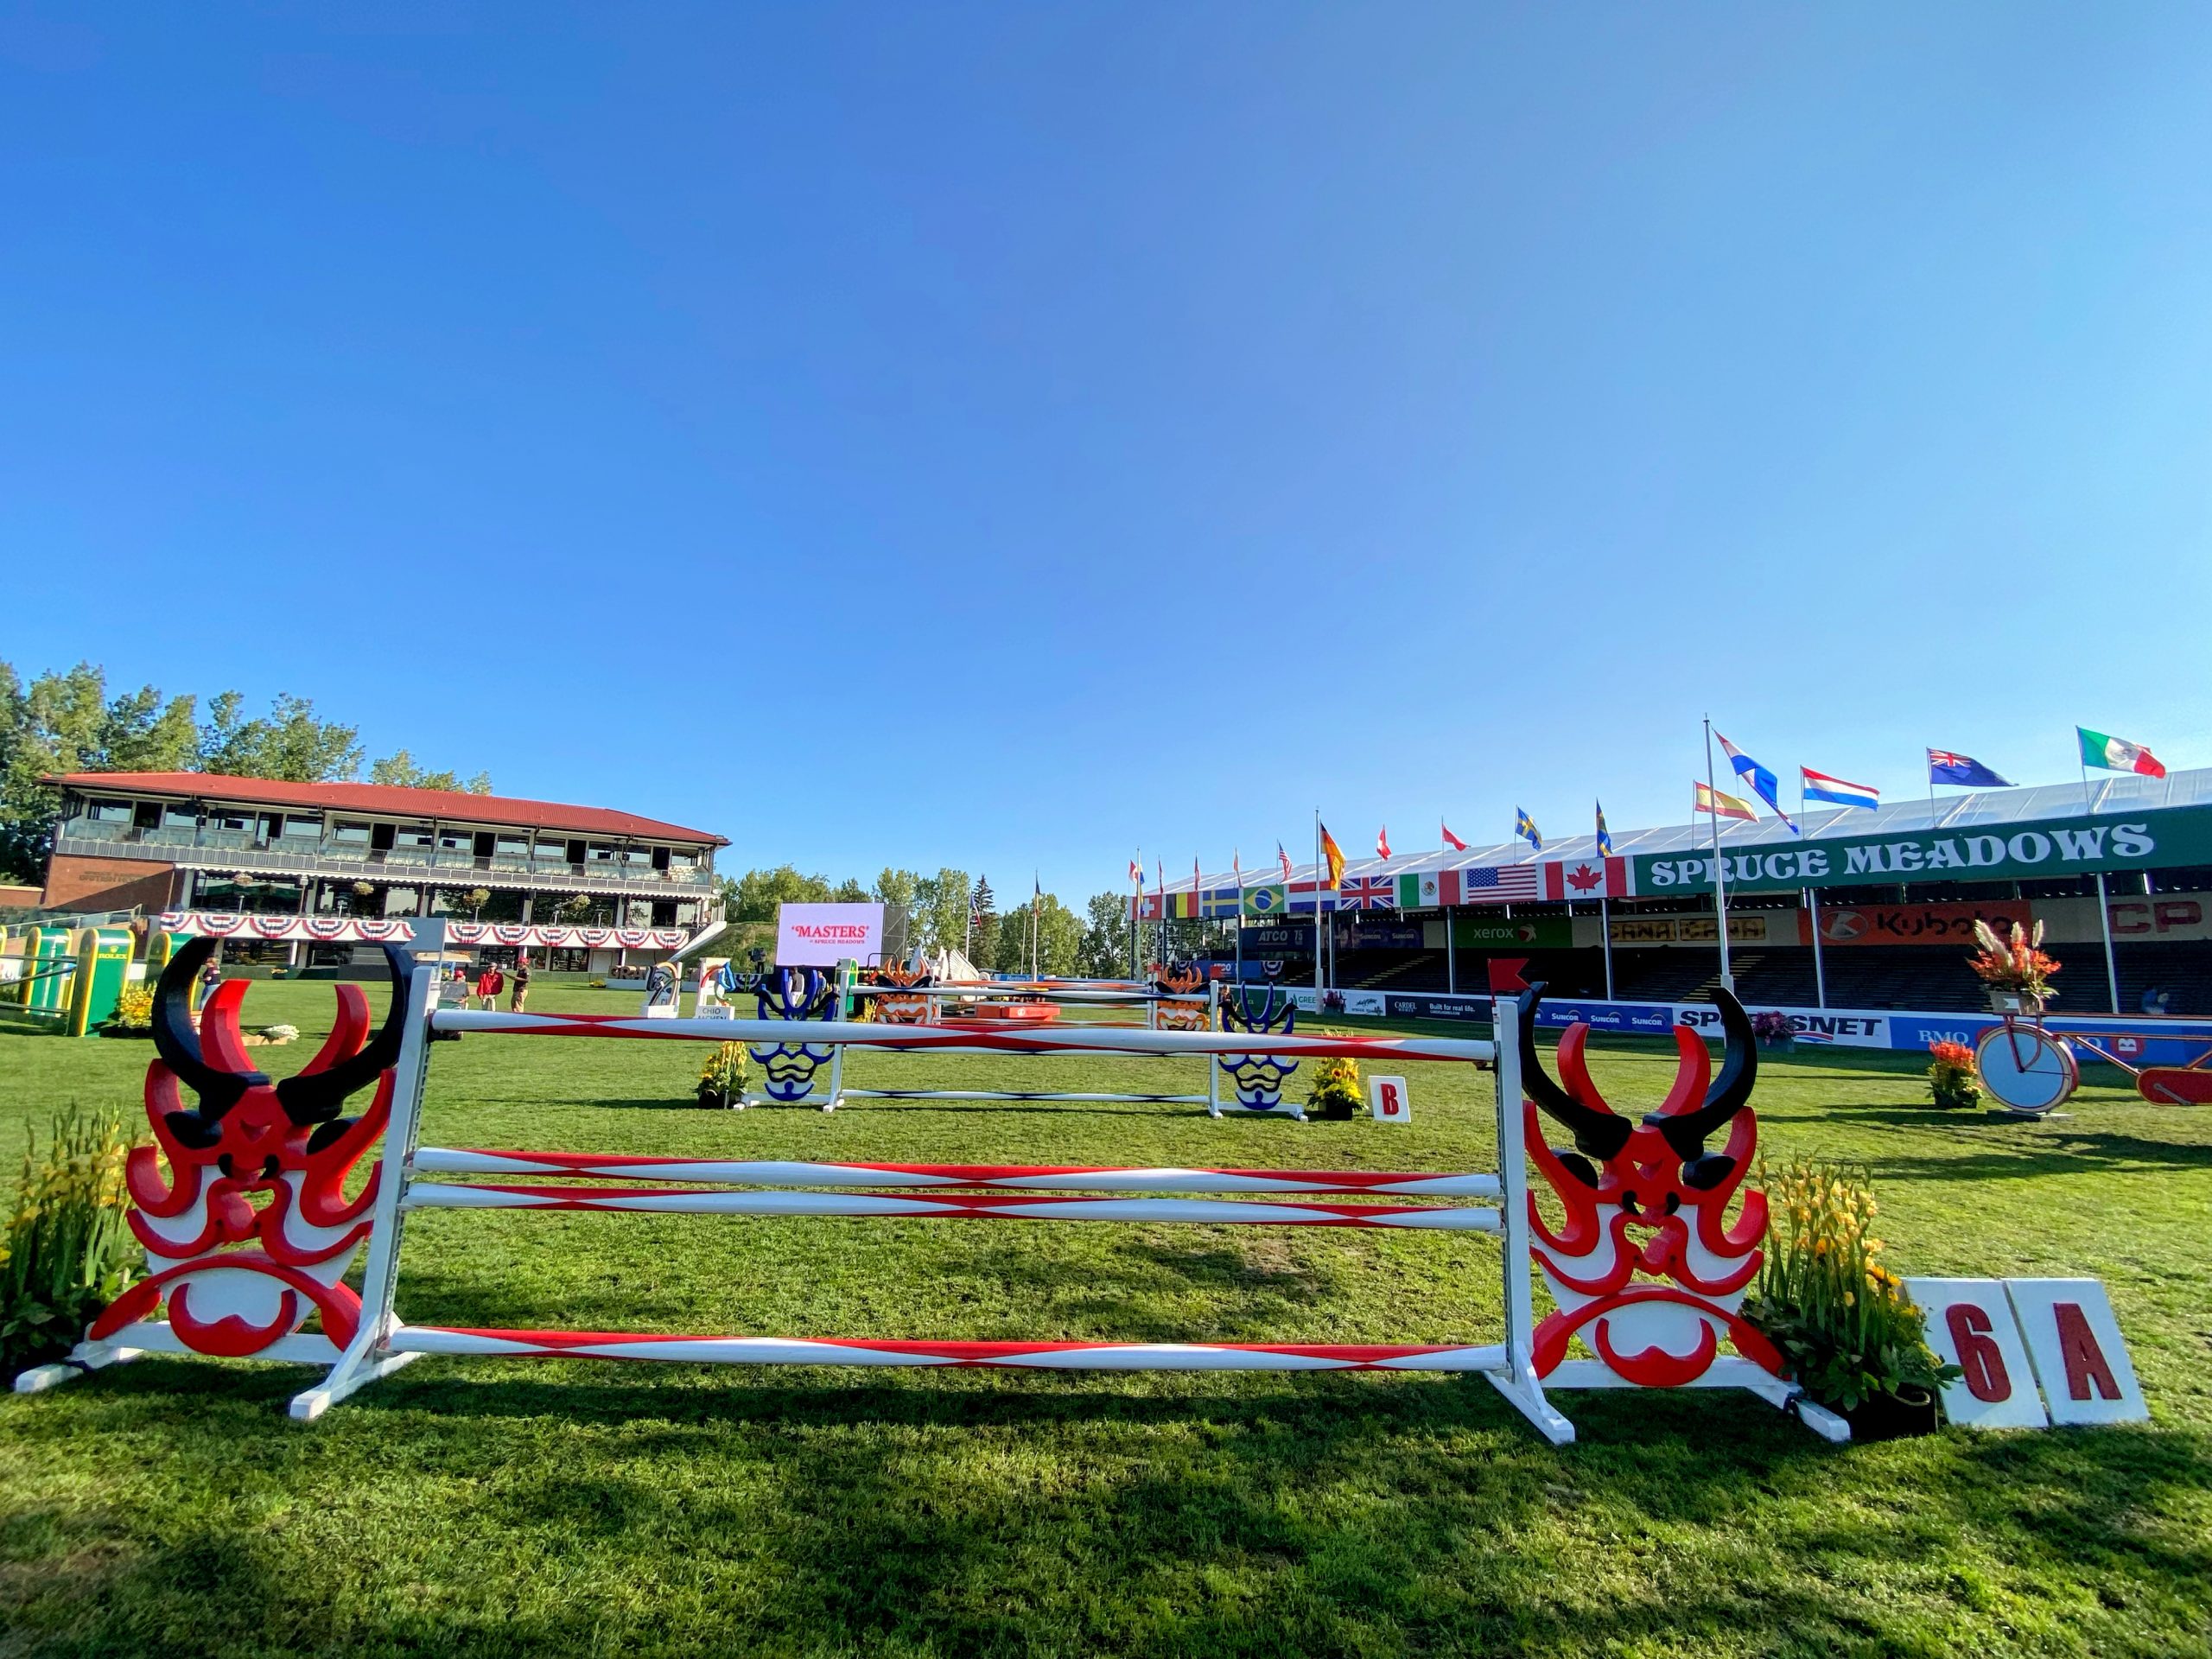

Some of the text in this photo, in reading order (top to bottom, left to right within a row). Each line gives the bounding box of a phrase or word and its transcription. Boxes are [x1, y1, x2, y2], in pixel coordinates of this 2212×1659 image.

[1651, 823, 2155, 887] SPRUCE MEADOWS
[2107, 901, 2202, 934] CP
[1258, 930, 1288, 942] ATCO
[1473, 927, 1514, 939] xerox
[1395, 1001, 1418, 1010] CARDEL
[1552, 1013, 1580, 1021] SUNCOR
[1591, 1014, 1620, 1024] SUNCOR
[1631, 1017, 1662, 1026] SUNCOR
[1680, 1010, 1882, 1037] SPSNET
[1918, 1029, 1968, 1045] BMO
[1380, 1084, 1400, 1116] B
[1945, 1302, 2123, 1403] 6 A
